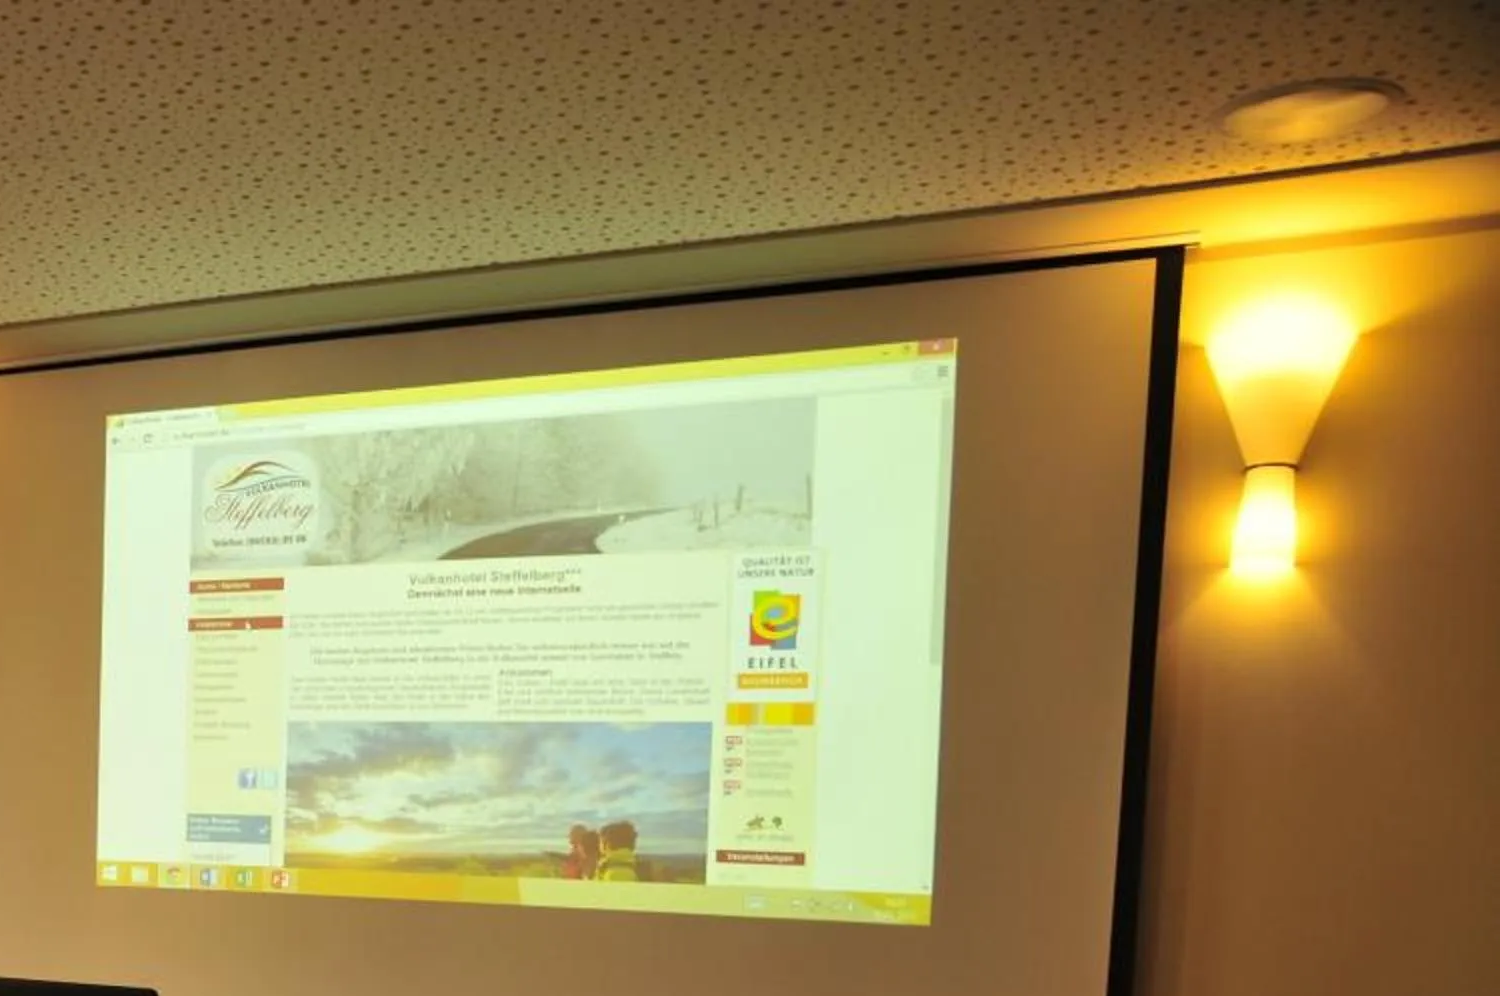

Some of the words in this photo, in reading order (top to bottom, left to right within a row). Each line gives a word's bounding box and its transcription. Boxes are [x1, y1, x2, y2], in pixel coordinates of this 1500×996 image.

[205, 494, 314, 529] Steffelberg
[409, 572, 487, 585] Vulkanhotel
[748, 657, 799, 669] EIFEL
